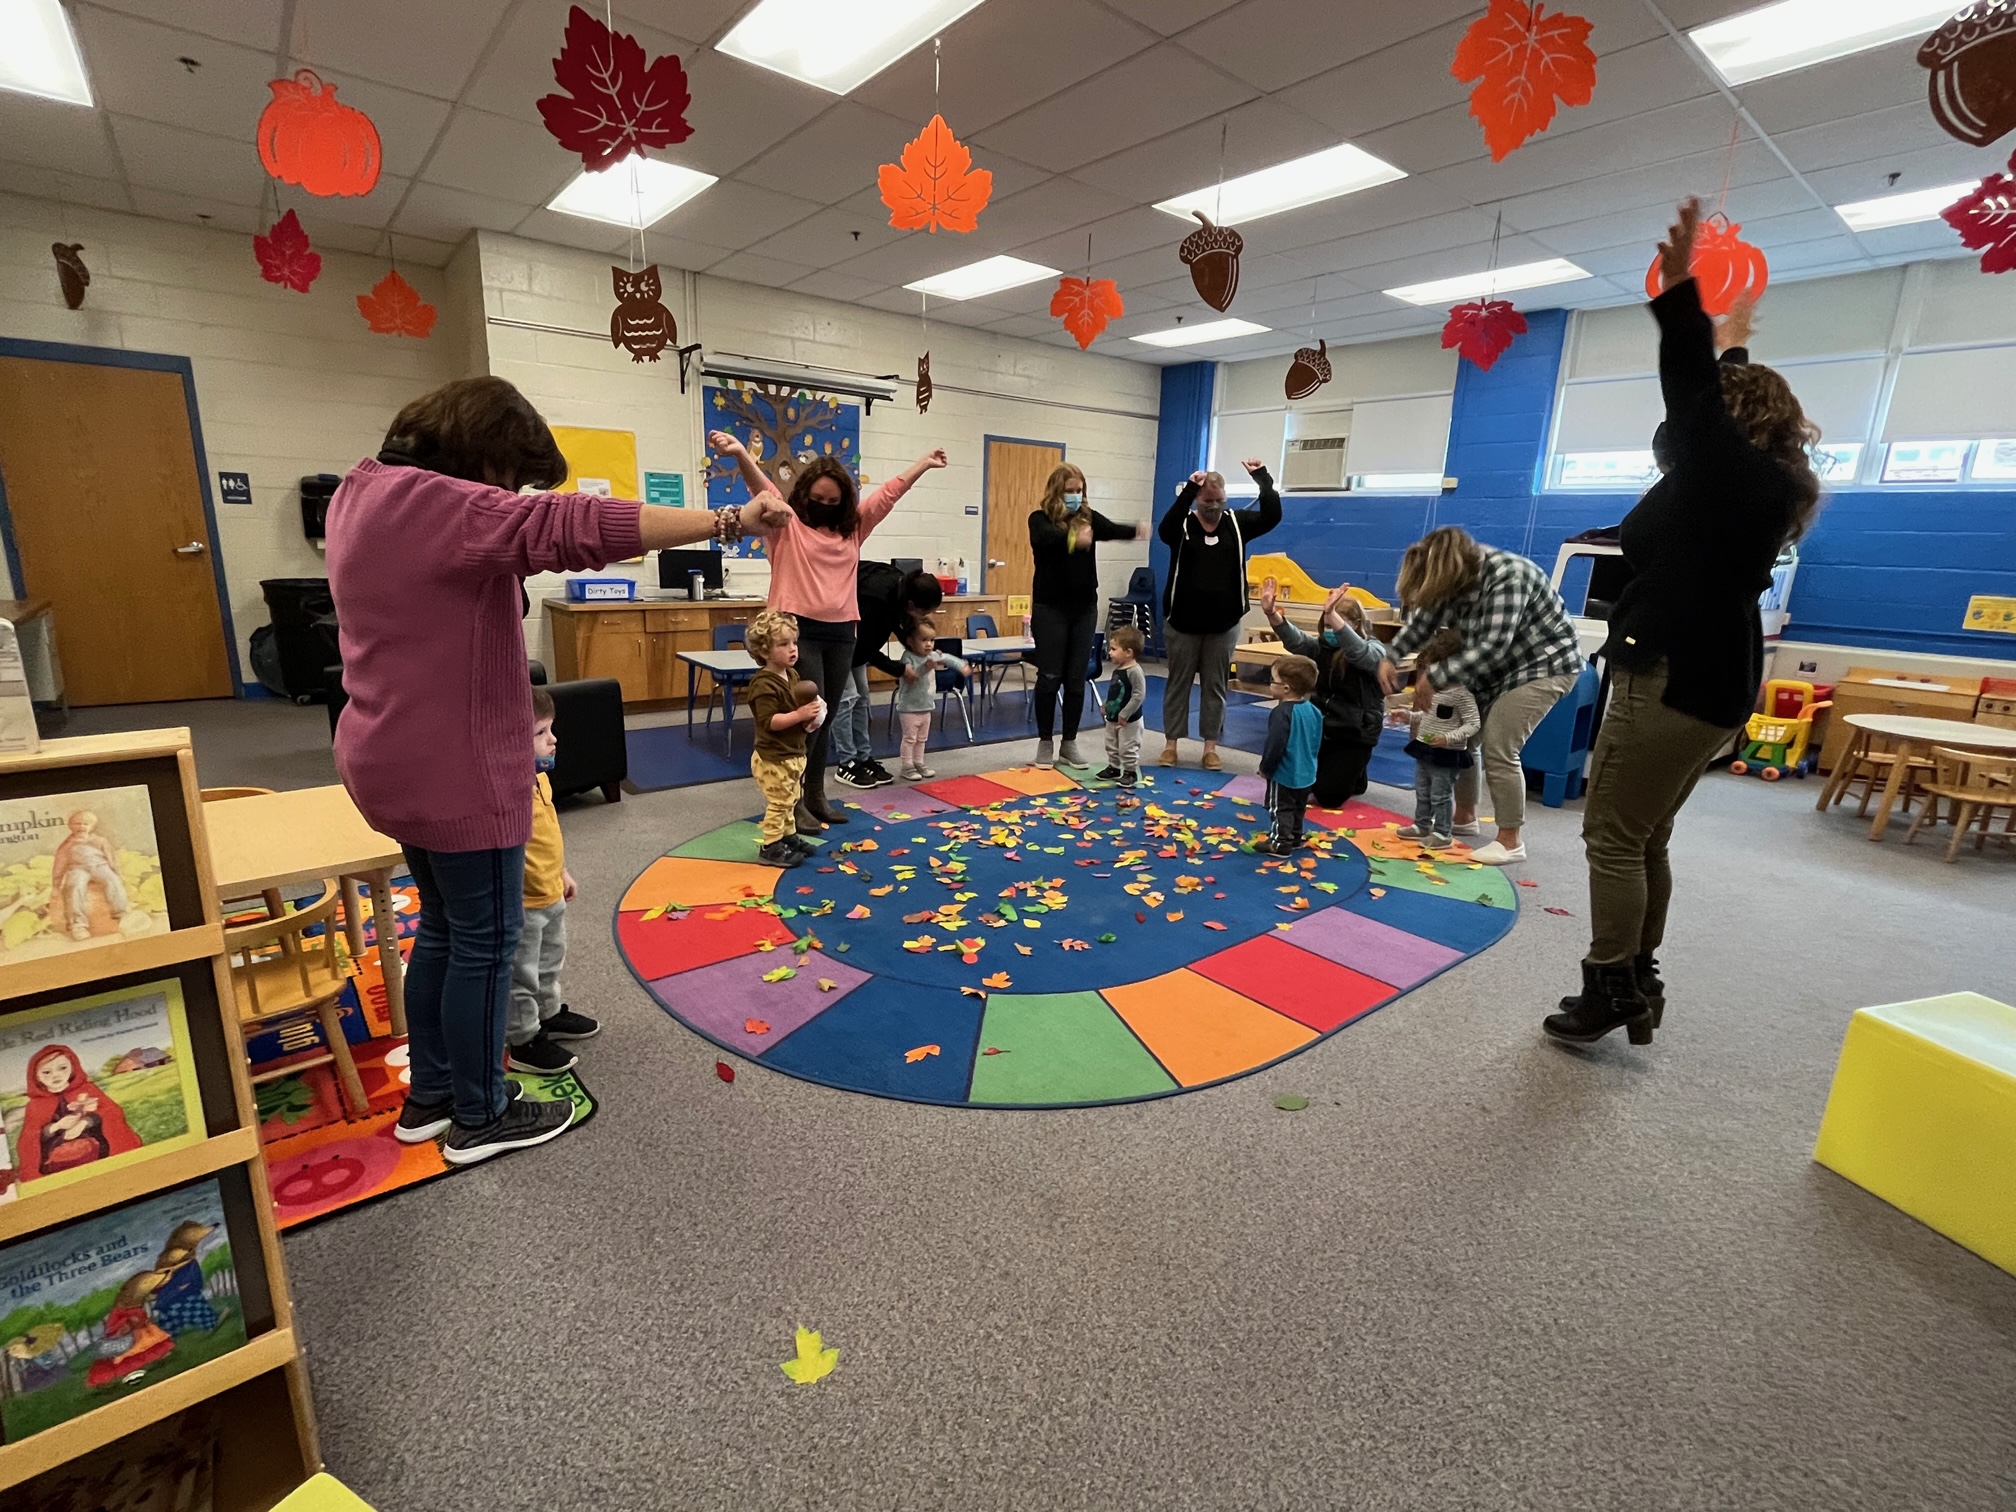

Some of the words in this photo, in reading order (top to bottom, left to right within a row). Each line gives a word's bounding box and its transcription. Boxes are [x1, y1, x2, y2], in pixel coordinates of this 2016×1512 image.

[587, 587, 607, 596] Dirty
[609, 587, 626, 596] Toys
[18, 1025, 55, 1046] Red
[58, 1015, 113, 1037] Riding
[113, 1003, 158, 1024] Hood
[96, 1234, 128, 1256] and
[11, 1281, 42, 1299] the
[44, 1261, 98, 1287] Three
[100, 1242, 150, 1267] Bears
